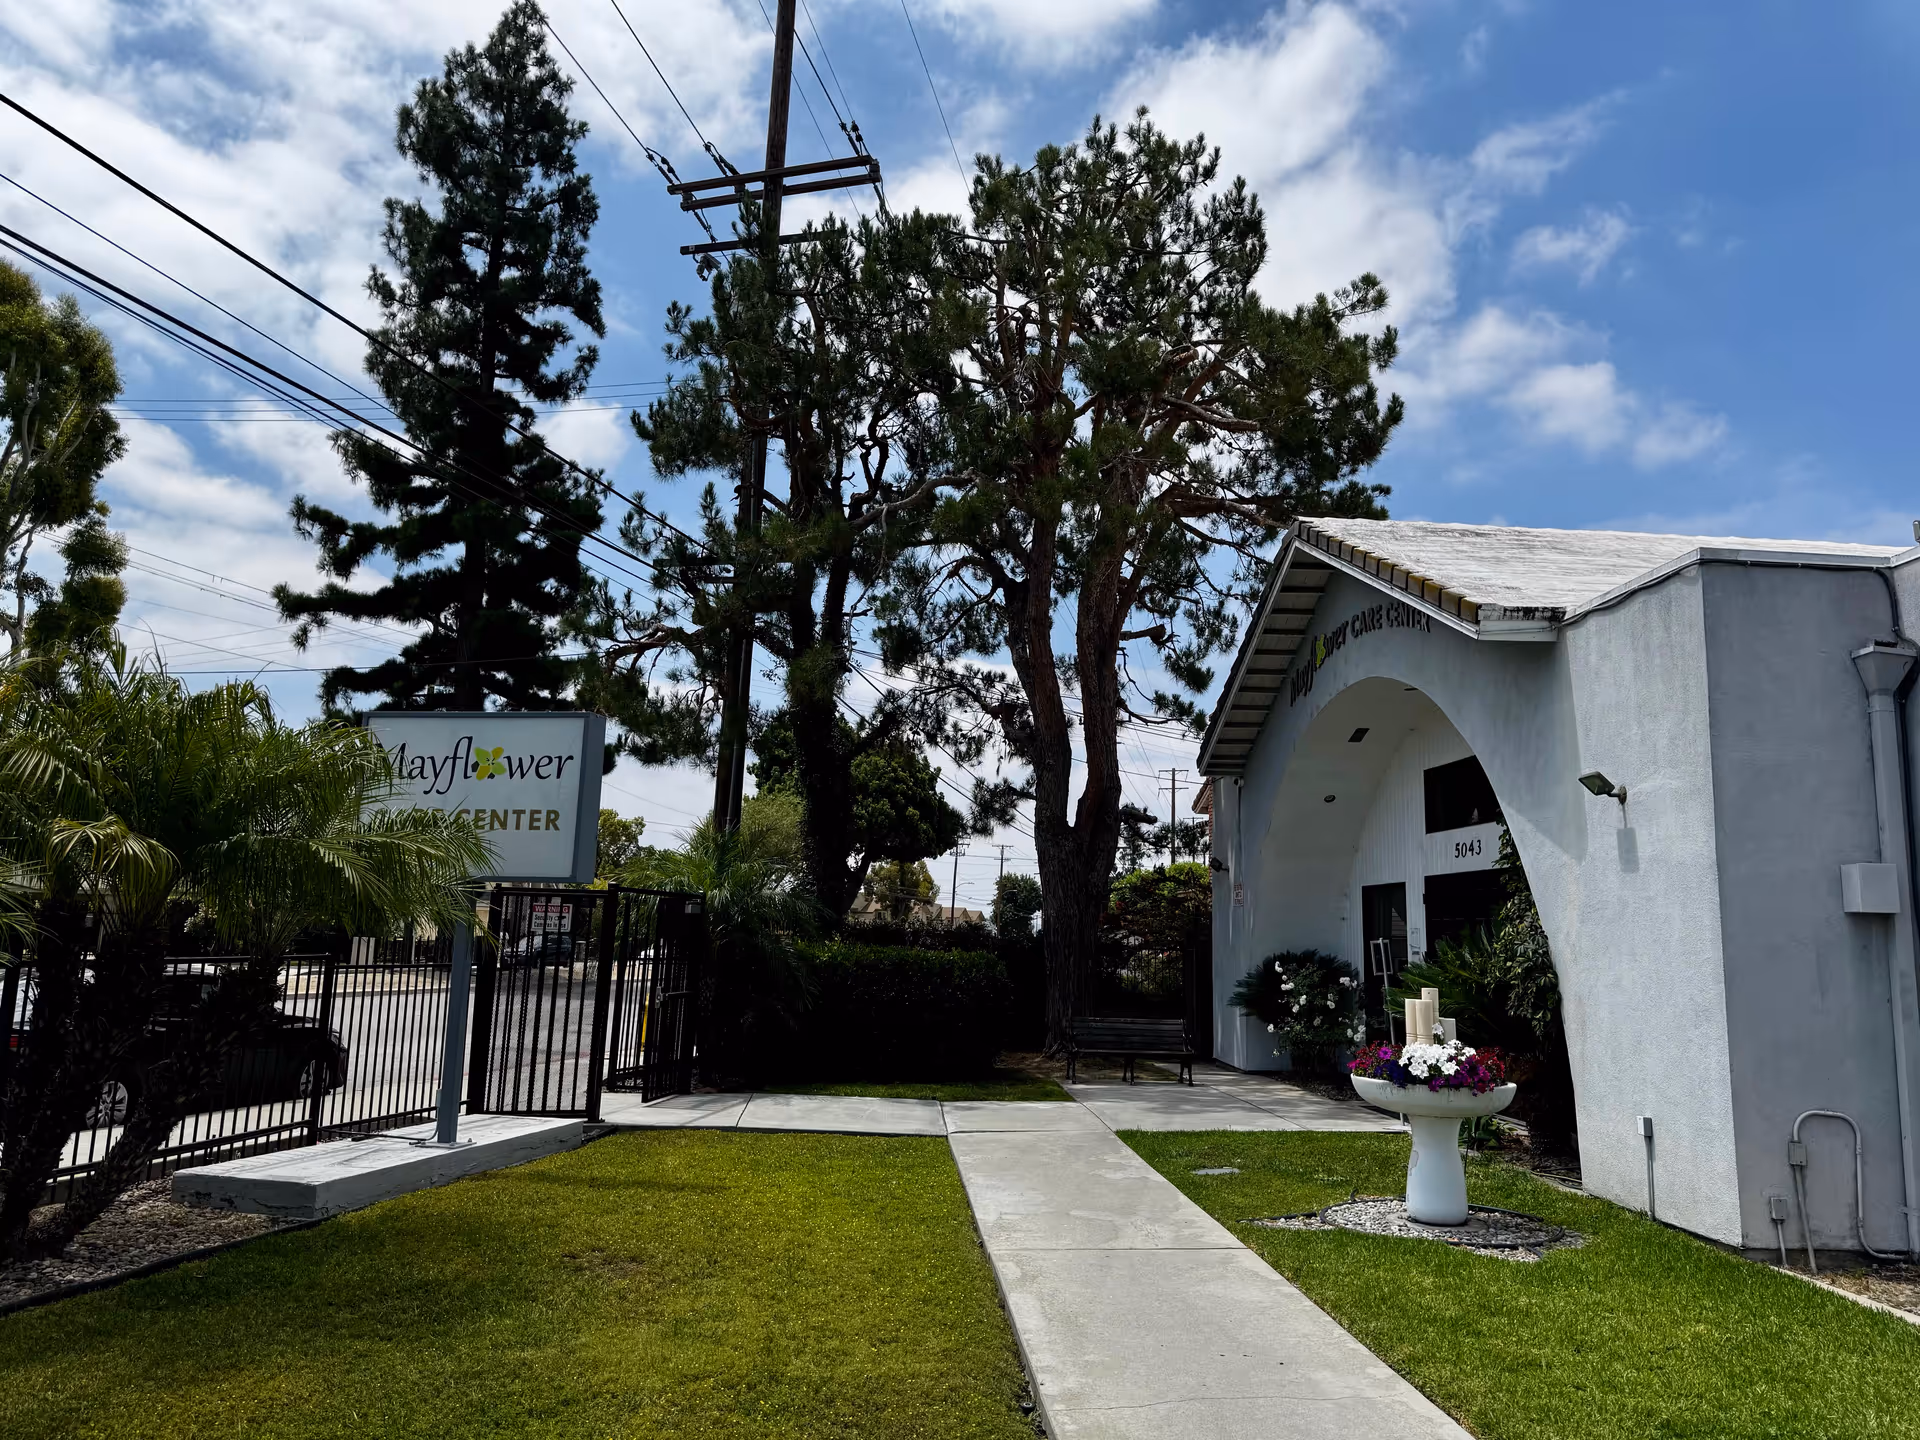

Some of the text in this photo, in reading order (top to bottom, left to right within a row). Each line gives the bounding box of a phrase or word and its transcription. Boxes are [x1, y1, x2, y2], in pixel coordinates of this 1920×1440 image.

[1290, 600, 1431, 707] Mayflower CARE CENTER
[455, 808, 560, 831] CENTER
[1455, 839, 1482, 859] 5043
[535, 914, 553, 922] Secuty
